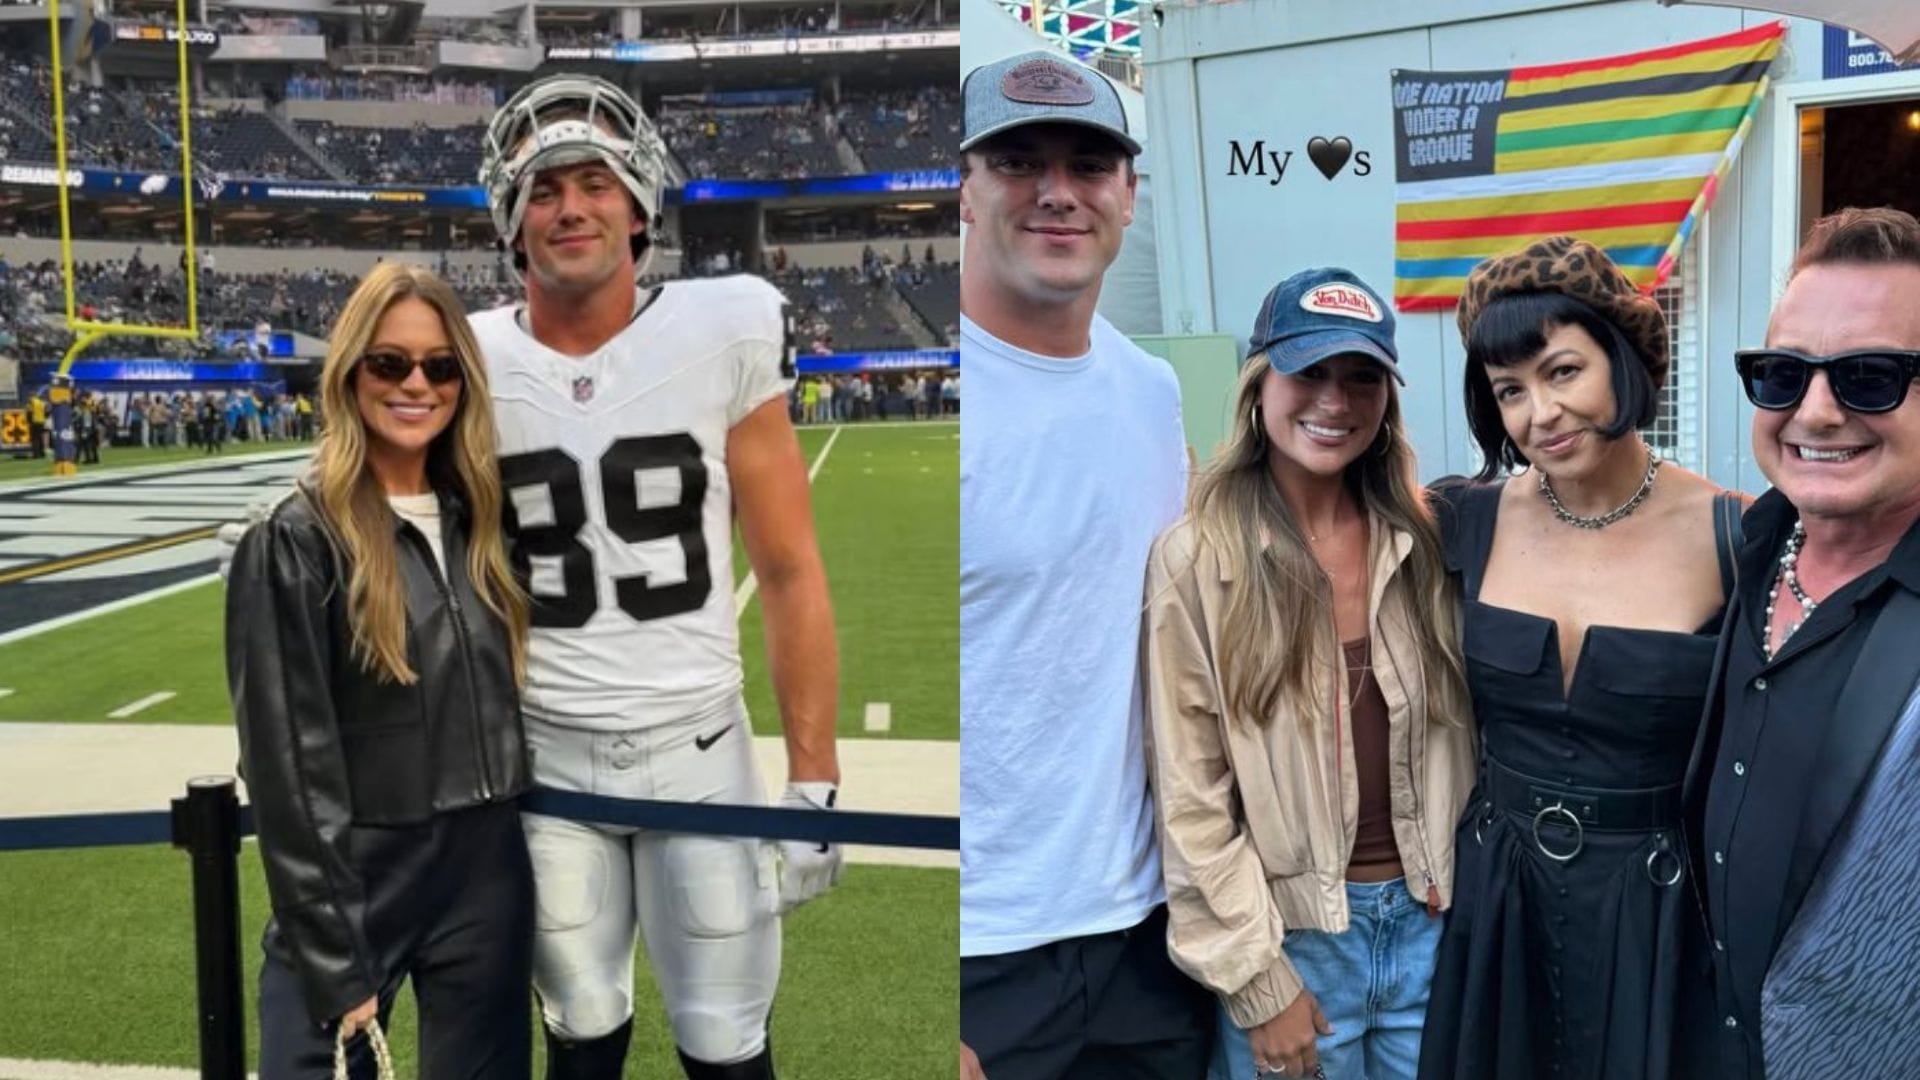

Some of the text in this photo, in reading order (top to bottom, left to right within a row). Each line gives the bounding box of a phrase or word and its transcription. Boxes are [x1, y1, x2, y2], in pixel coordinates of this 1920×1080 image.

[1422, 79, 1505, 105] NATION
[1403, 105, 1479, 137] UNDER A
[1312, 287, 1338, 306] Von
[498, 432, 713, 629] 89
